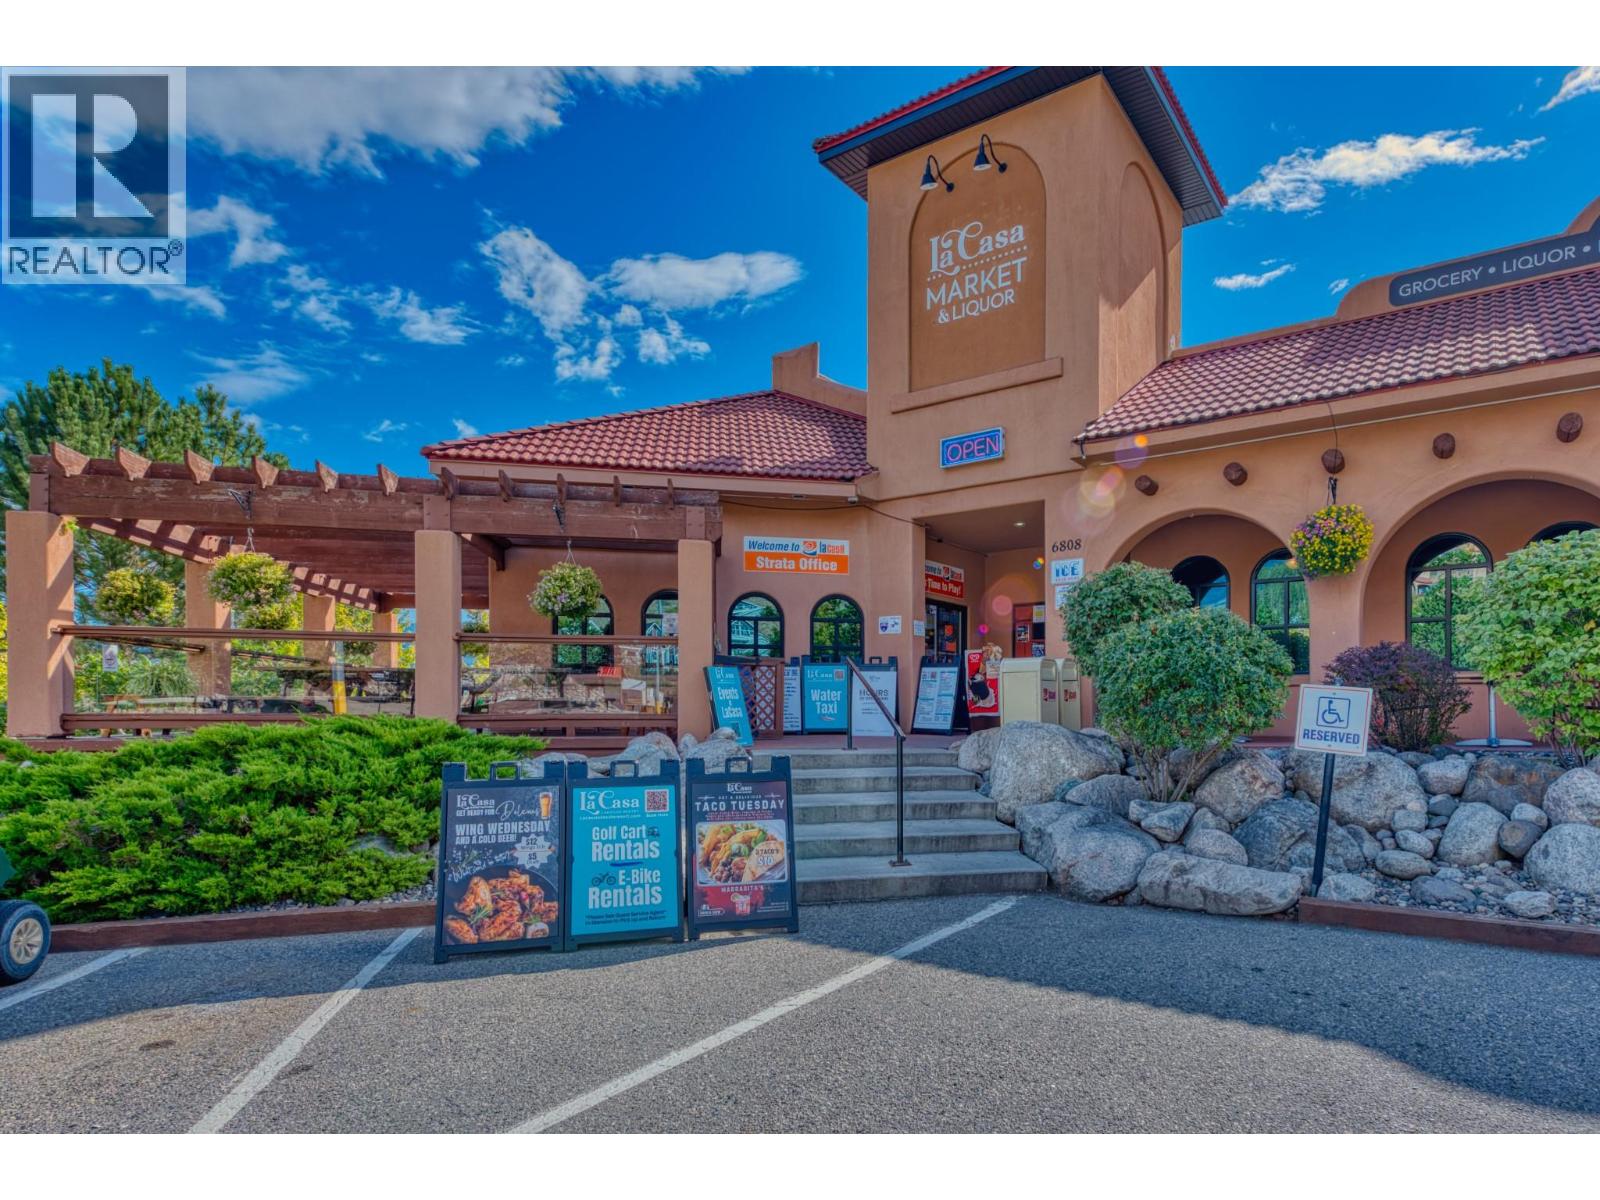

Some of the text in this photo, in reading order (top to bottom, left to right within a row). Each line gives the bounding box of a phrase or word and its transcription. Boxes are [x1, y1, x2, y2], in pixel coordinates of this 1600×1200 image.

[957, 221, 1025, 261] Casa
[1399, 266, 1483, 297] GROCERY
[1502, 245, 1576, 274] LIQUOR
[926, 256, 1028, 311] MARKET
[937, 288, 1015, 324] & LIQUOR
[946, 436, 1000, 462] OPEN
[748, 540, 789, 552] Welcome
[791, 542, 800, 552] to
[1051, 538, 1082, 553] 6808
[756, 556, 838, 571] Strata Office
[1055, 563, 1079, 577] ICE
[928, 578, 941, 590] Time
[717, 687, 739, 700] Events
[810, 689, 842, 701] Water
[816, 702, 838, 714] Taxi
[1302, 728, 1360, 745] RESERVED
[598, 790, 640, 809] Casa
[695, 799, 785, 812] TACO TUESDAY
[456, 809, 466, 817] GET
[467, 809, 484, 817] READY
[455, 820, 551, 836] WING WEDNESDAY
[592, 824, 646, 840] Golf Cart
[455, 836, 470, 845] AND
[471, 835, 477, 844] A
[479, 834, 496, 844] COLD
[592, 838, 660, 862] Rentals
[618, 867, 661, 885] E-Bike
[588, 883, 662, 909] Rentals
